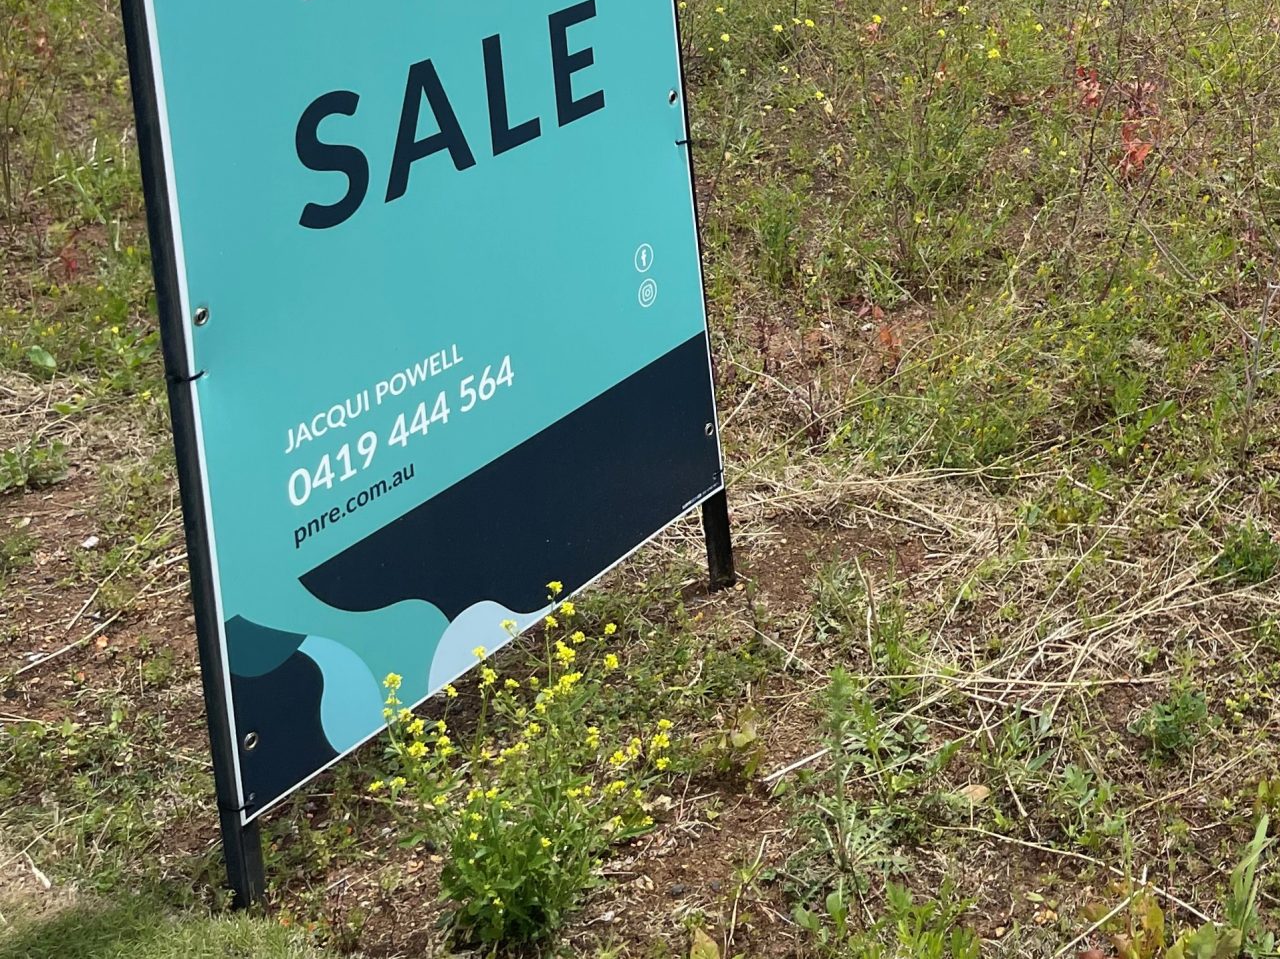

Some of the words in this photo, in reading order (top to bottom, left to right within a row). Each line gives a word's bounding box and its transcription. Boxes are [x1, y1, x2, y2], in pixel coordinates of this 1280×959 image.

[285, 389, 370, 454] JACQUI
[375, 343, 464, 406] POWELL
[288, 430, 378, 507] 0419
[387, 390, 451, 449] 444
[460, 354, 515, 413] 564
[294, 463, 415, 549] pnre.com.au
